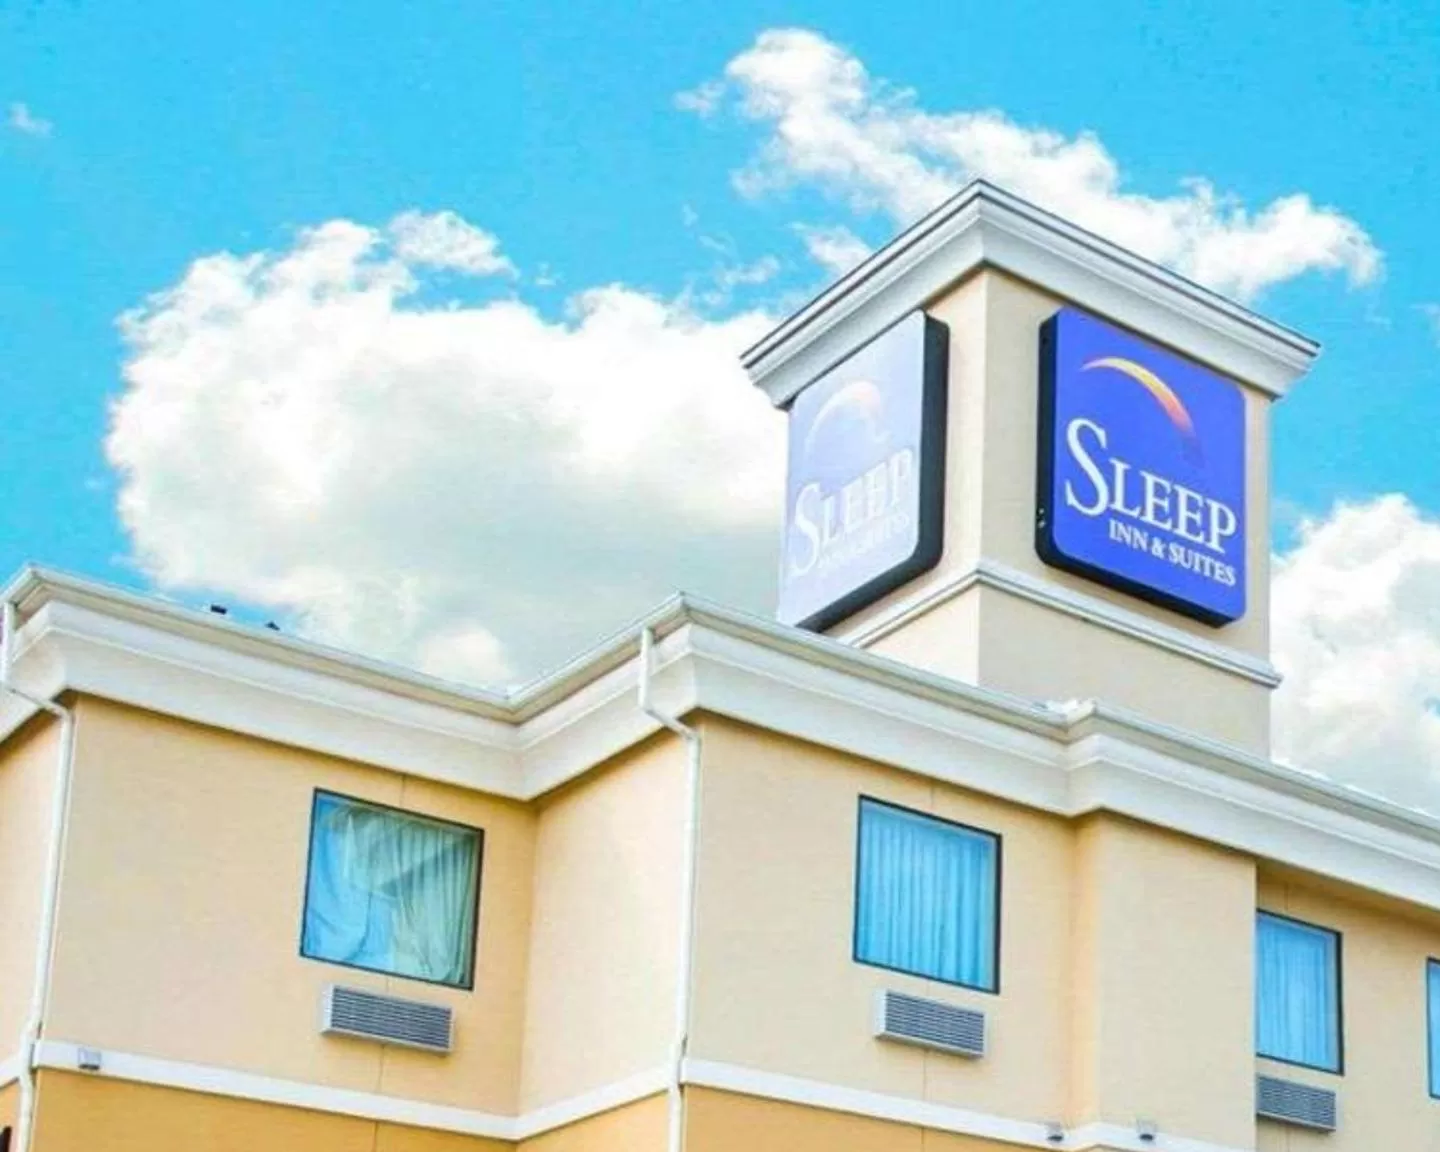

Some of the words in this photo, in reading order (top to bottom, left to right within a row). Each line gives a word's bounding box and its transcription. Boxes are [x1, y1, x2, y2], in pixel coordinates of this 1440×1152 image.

[789, 449, 912, 577] SLEEP
[1064, 418, 1237, 554] SLEEP
[1108, 518, 1149, 552] INN
[1151, 536, 1167, 560] &
[1168, 542, 1237, 587] SUITES
